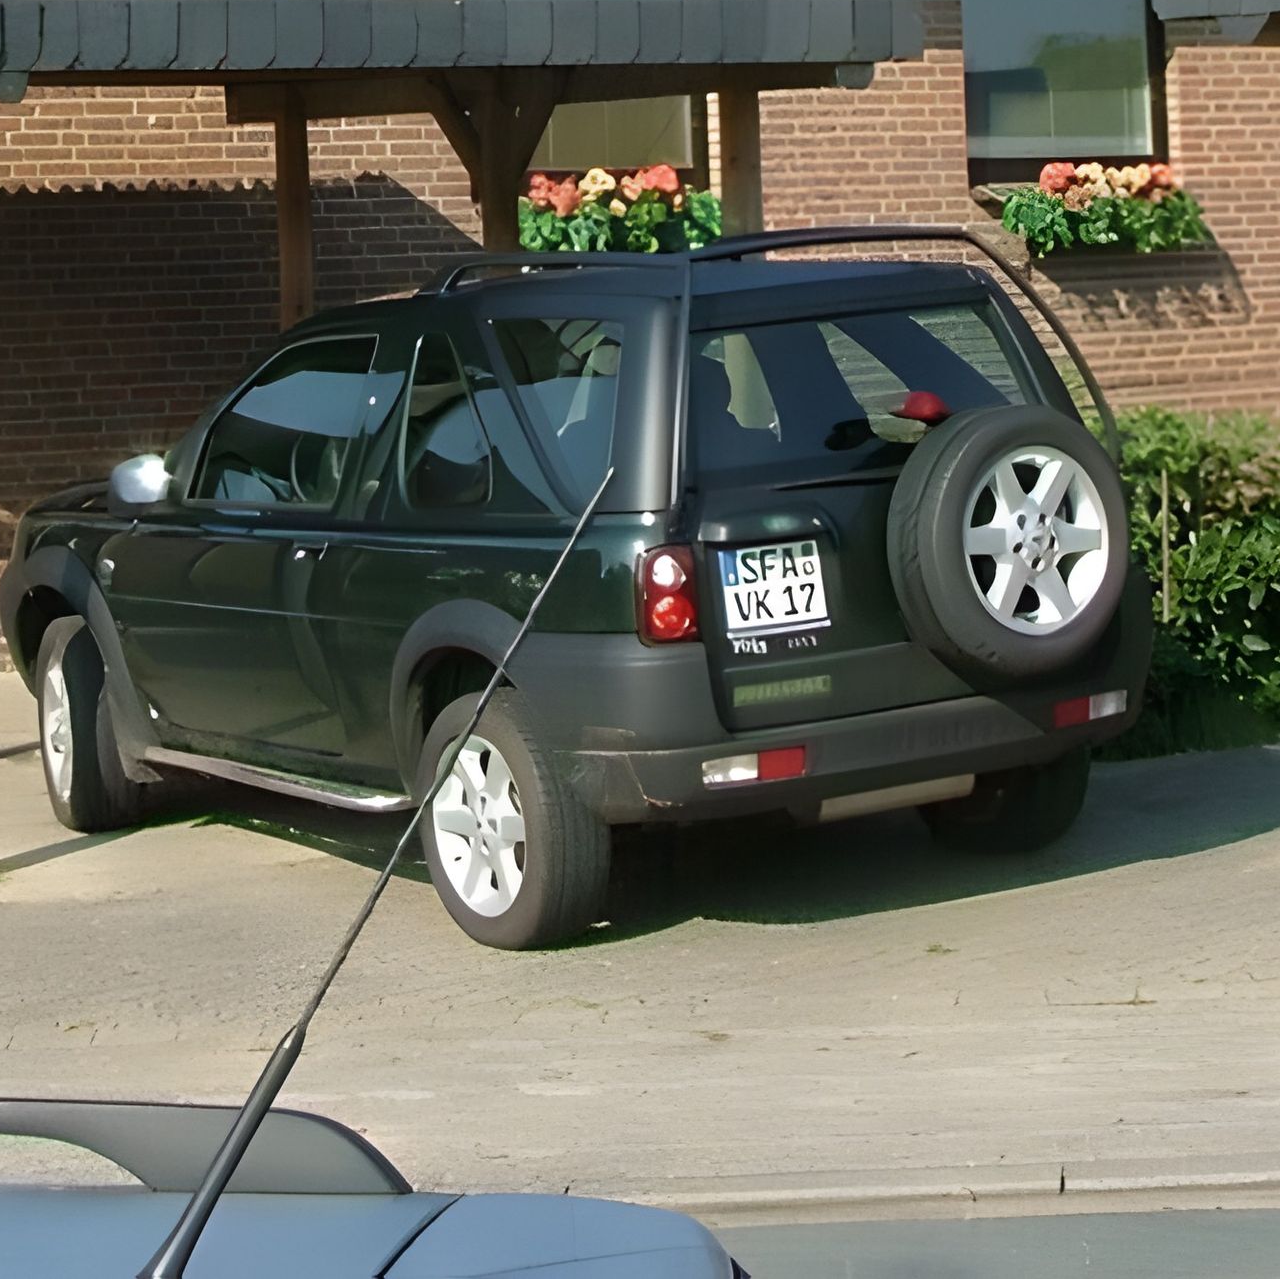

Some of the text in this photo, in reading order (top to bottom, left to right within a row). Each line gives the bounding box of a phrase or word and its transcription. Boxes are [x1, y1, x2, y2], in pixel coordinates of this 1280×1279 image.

[741, 547, 799, 584] SFA
[734, 583, 815, 621] VK 17
